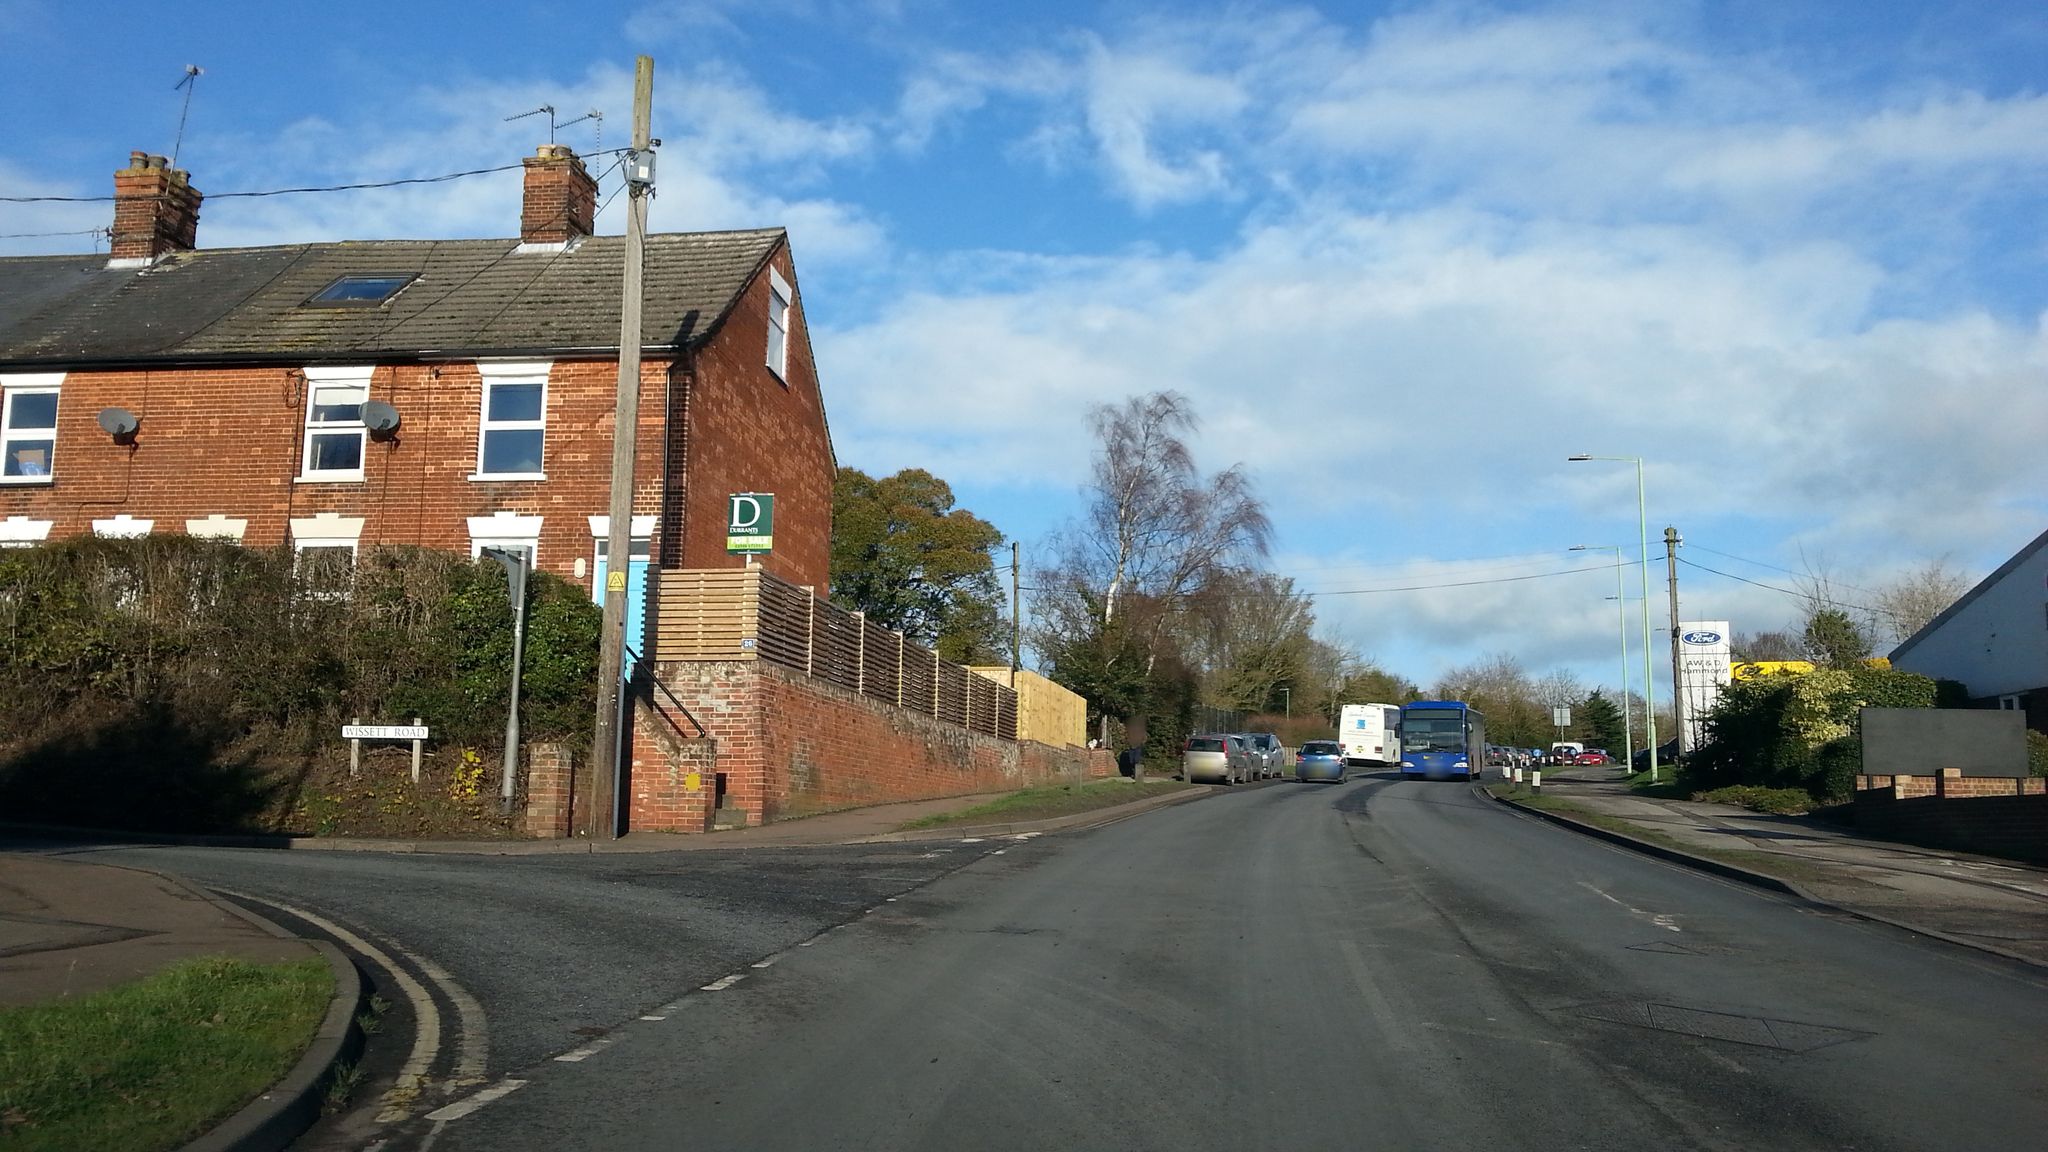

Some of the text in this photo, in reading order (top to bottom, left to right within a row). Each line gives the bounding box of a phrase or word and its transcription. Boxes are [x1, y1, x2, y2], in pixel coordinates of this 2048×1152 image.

[730, 497, 760, 527] D
[345, 727, 425, 737] WISSETT ROAD
